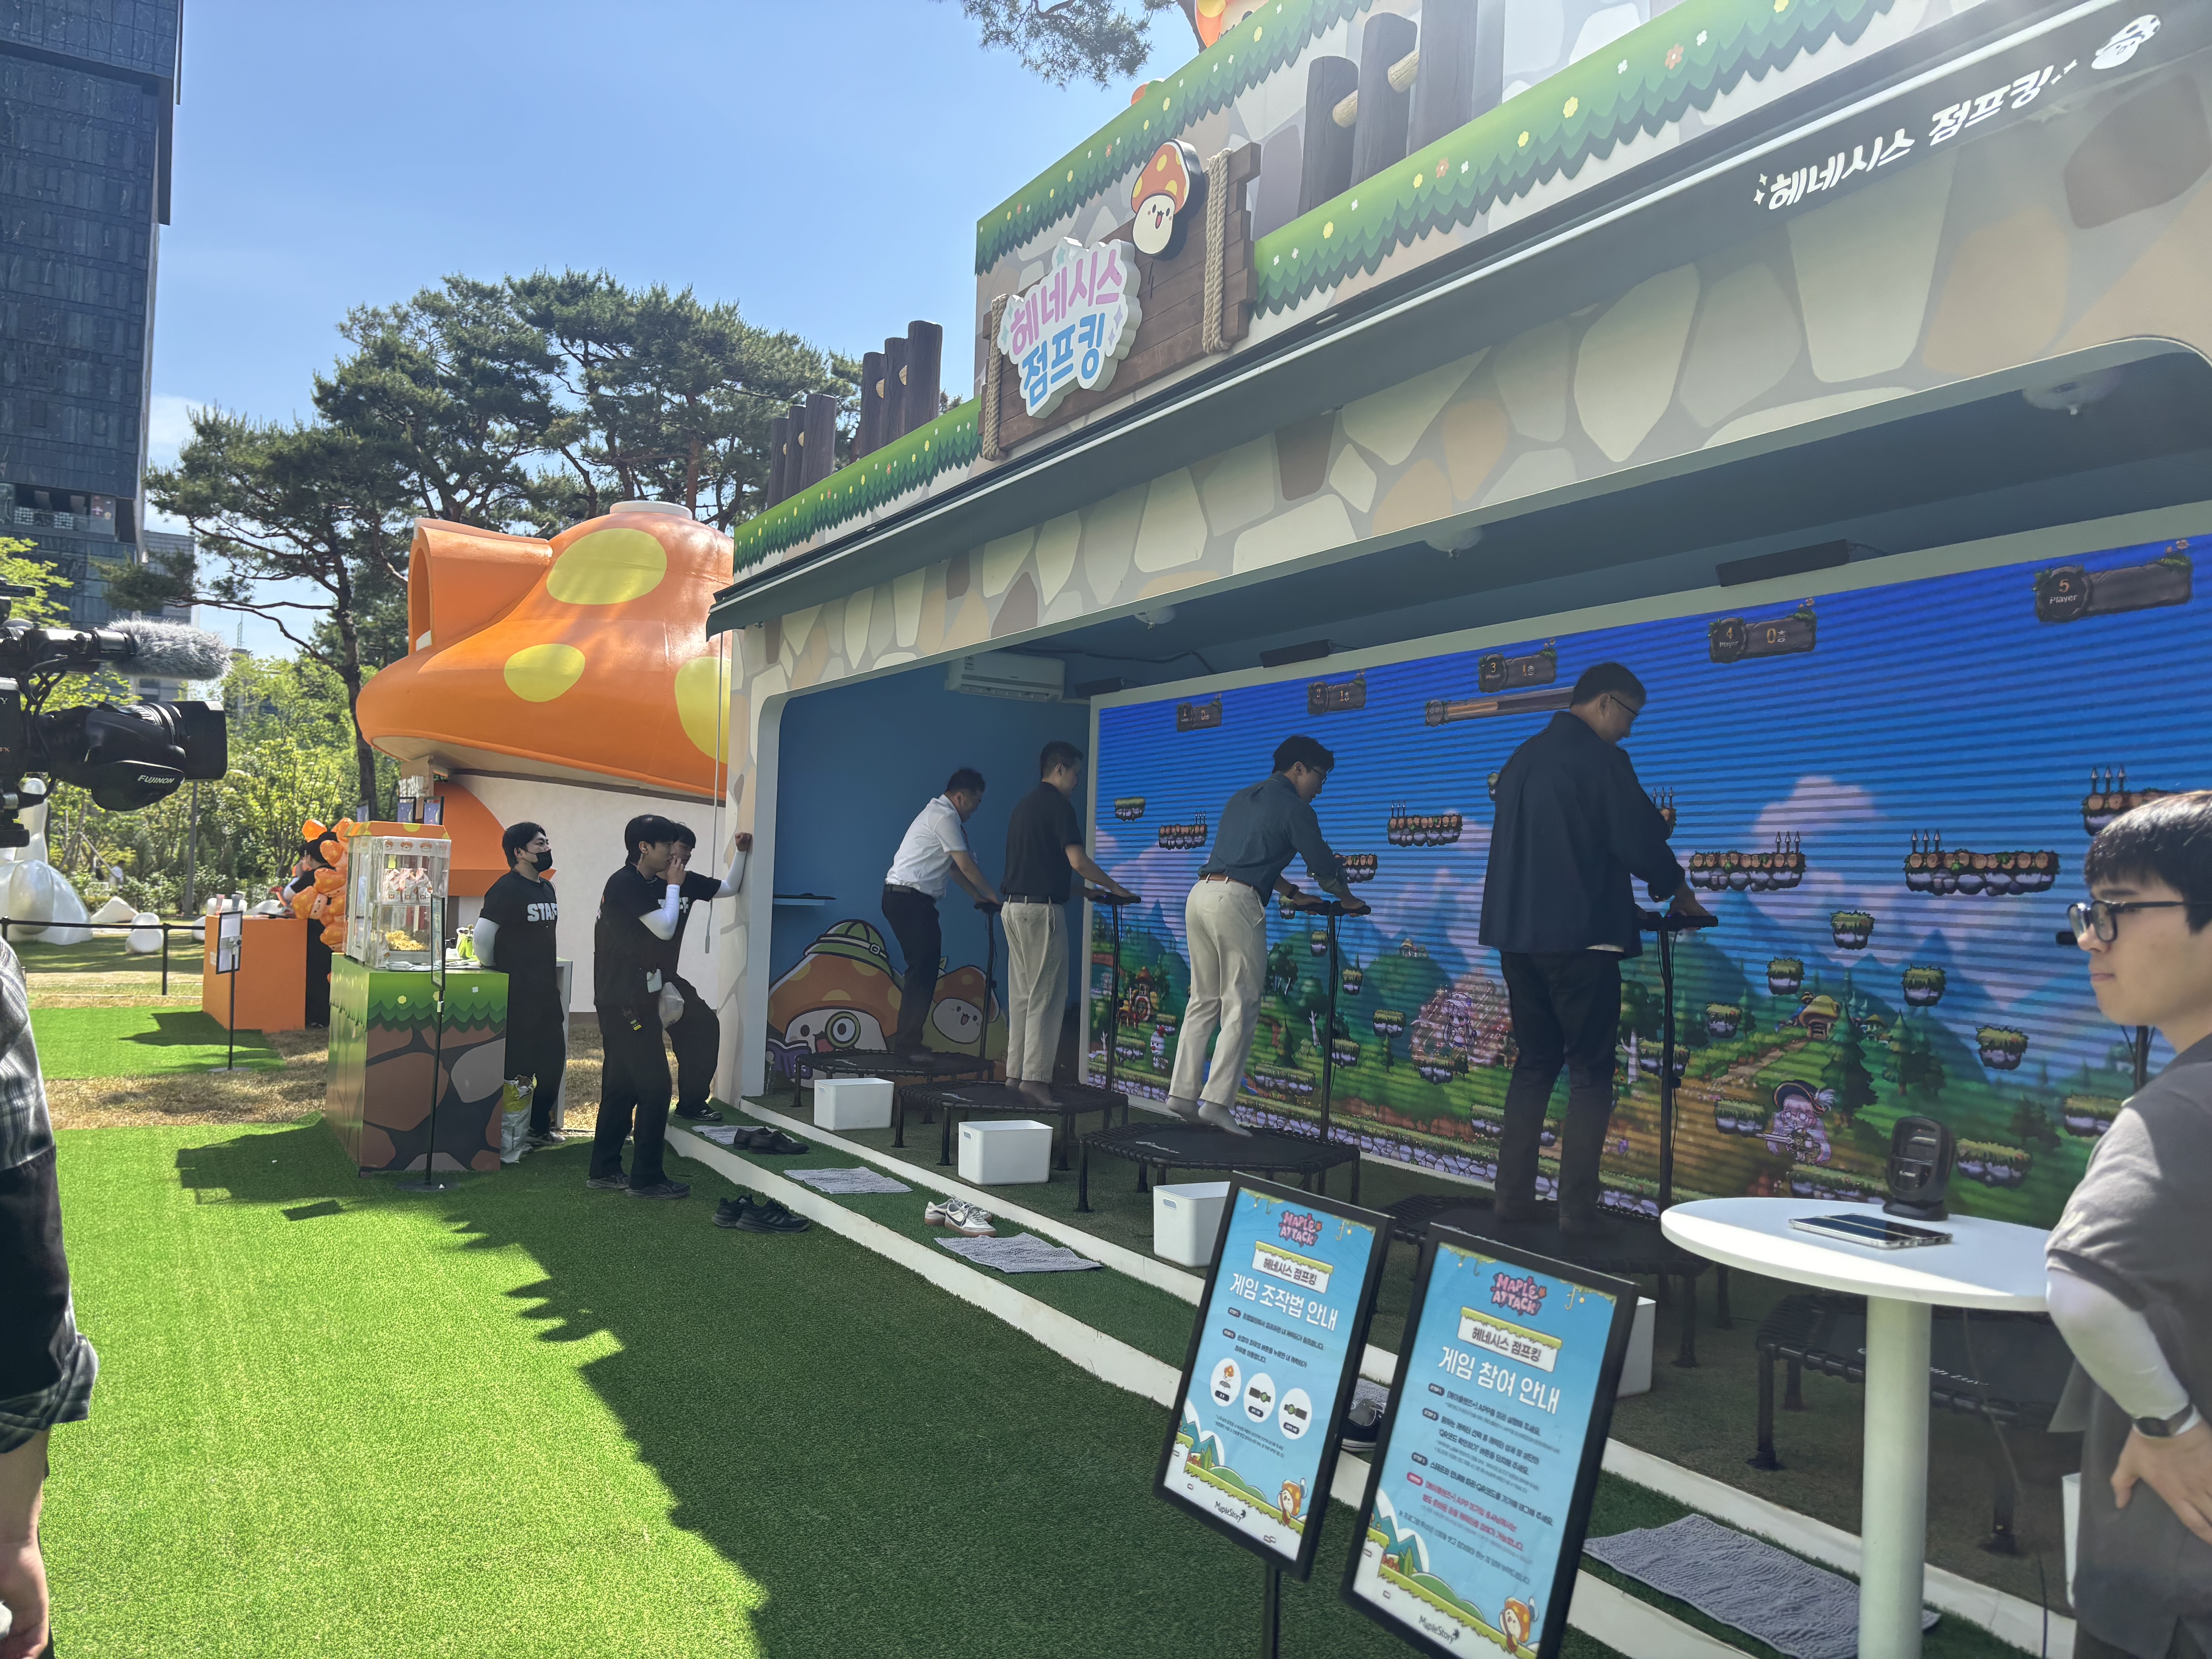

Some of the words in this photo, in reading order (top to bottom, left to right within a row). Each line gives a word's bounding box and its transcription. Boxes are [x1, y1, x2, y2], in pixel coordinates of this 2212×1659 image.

[1769, 128, 1915, 210] 헤네시스
[1929, 65, 2055, 146] 점프킹
[1010, 249, 1123, 355] 헤네시스
[1022, 313, 1105, 408] 점프킹
[2050, 594, 2078, 604] Player
[2059, 579, 2070, 592] 5
[1726, 628, 1733, 639] 4
[1491, 663, 1496, 672] 3
[138, 775, 175, 783] FUJINON
[527, 903, 557, 922] STAF
[1283, 1211, 1316, 1233] MAPLE
[1264, 1258, 1292, 1276] 헤네시스
[1294, 1267, 1316, 1285] 점프킹
[1496, 1273, 1538, 1300] MAPLE
[1230, 1273, 1259, 1301] 게임
[1260, 1284, 1304, 1319] 조작법
[1306, 1301, 1338, 1331] 안내
[1472, 1327, 1509, 1351] 헤네시스
[1512, 1341, 1541, 1362] 점프킹
[1438, 1346, 1475, 1380] 게임
[1478, 1362, 1516, 1397] 참여
[1519, 1377, 1560, 1414] 안내
[1215, 1501, 1242, 1523] MapleStory
[1419, 1615, 1455, 1644] MapleStory
